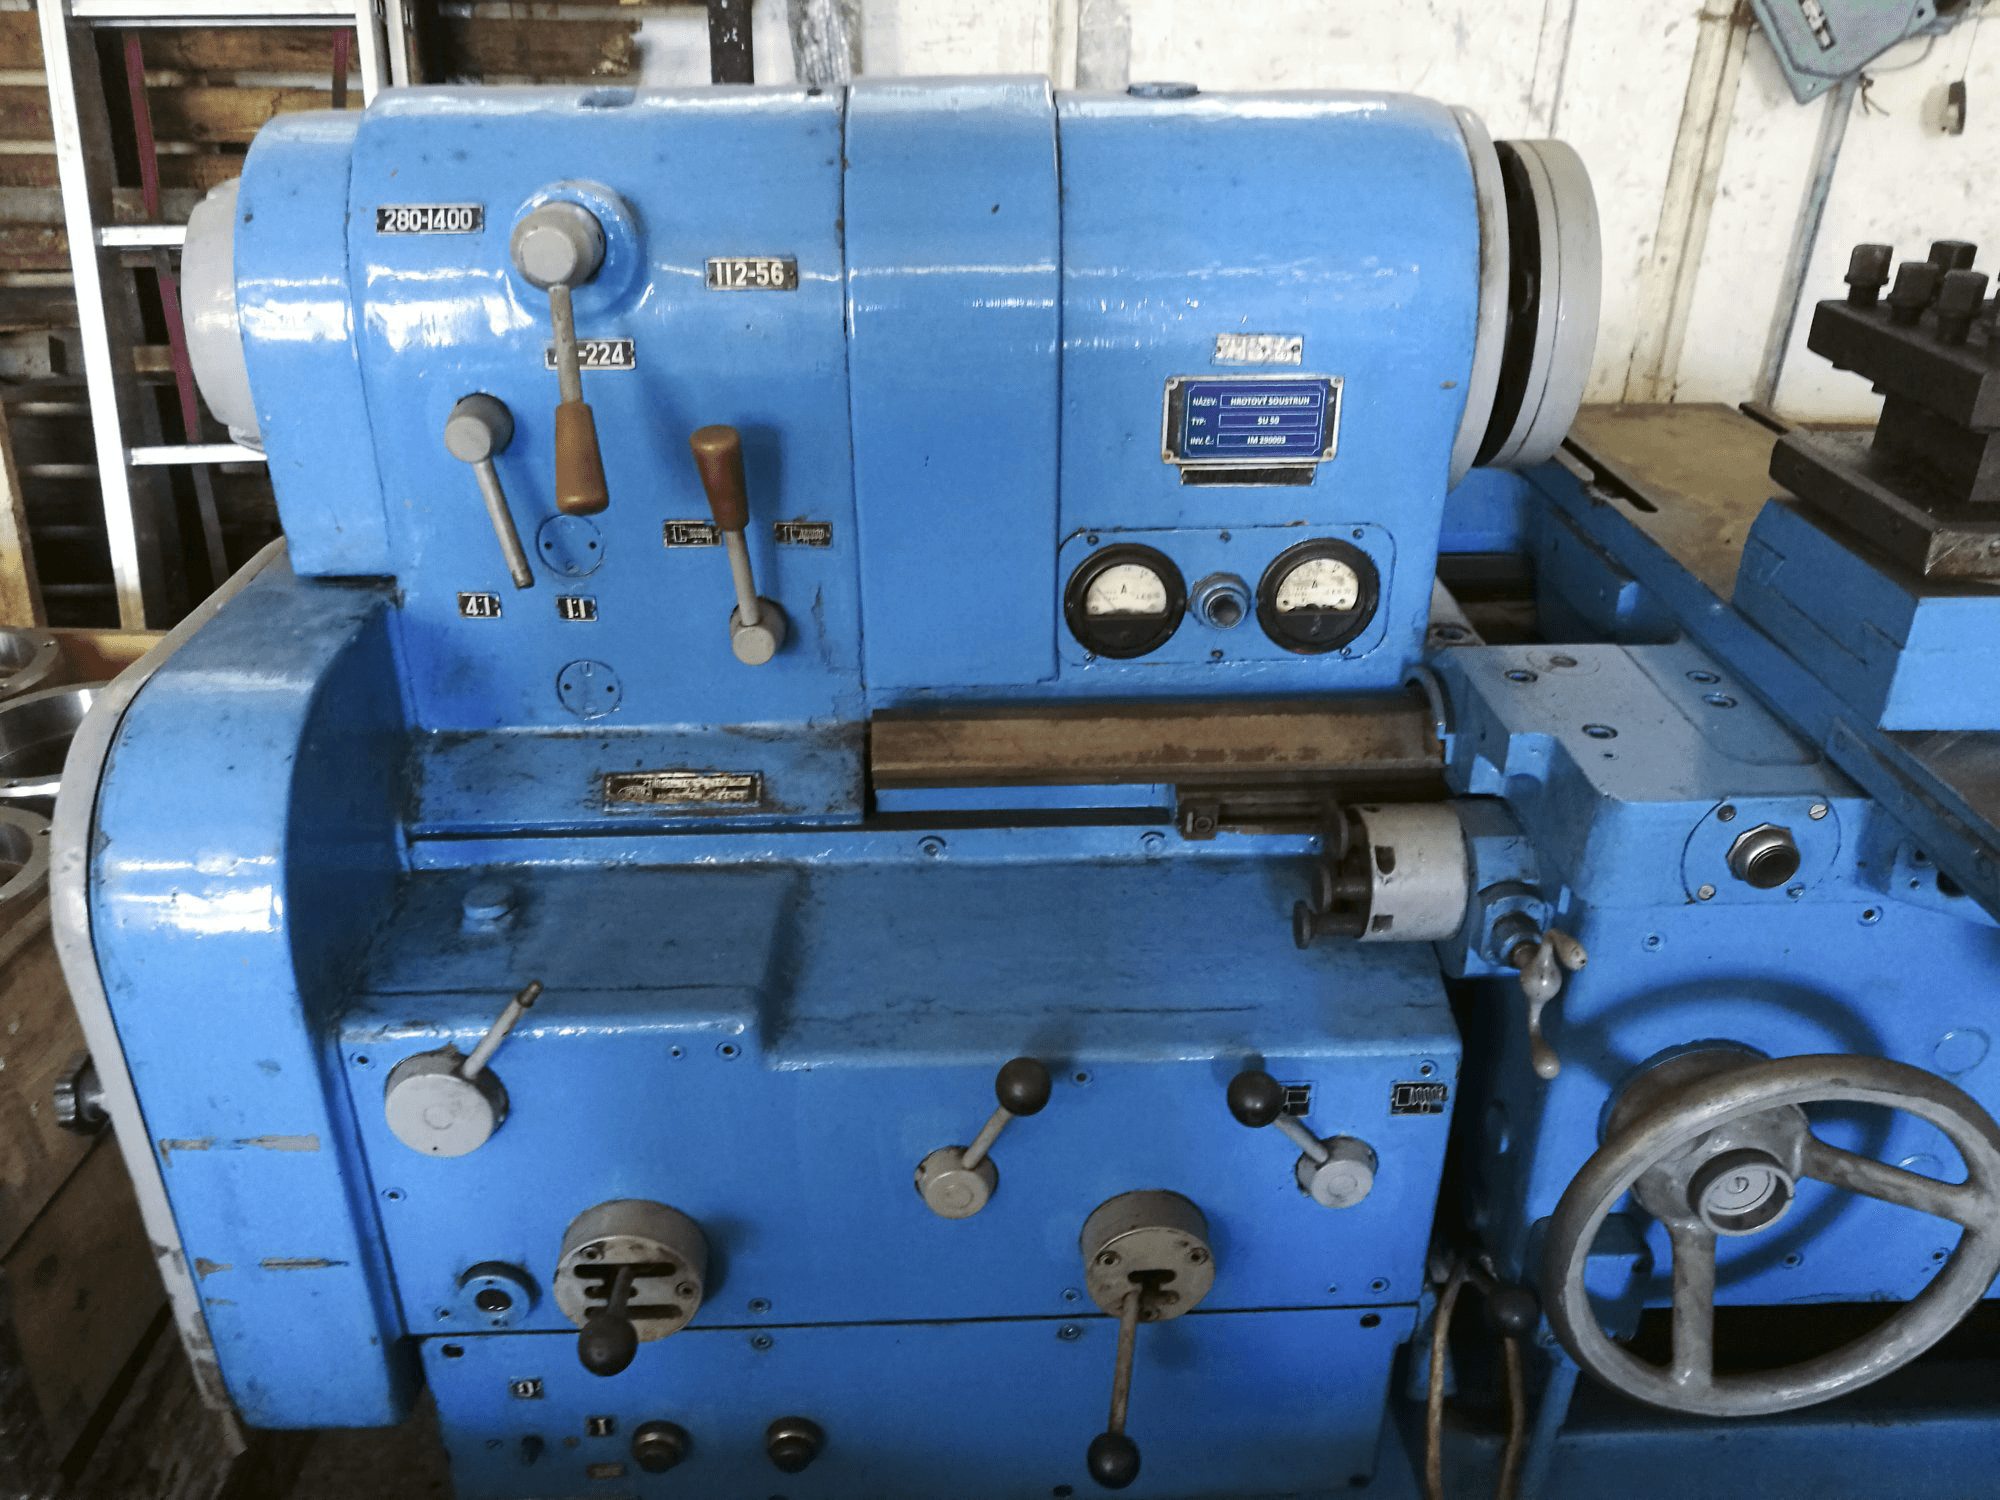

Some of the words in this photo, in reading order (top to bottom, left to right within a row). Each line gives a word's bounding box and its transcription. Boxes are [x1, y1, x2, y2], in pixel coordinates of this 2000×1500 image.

[384, 208, 473, 232] 280-1400
[716, 261, 785, 287] 112-56
[1230, 395, 1267, 406] HROTOVÝ
[1268, 395, 1310, 406] SOUSTRUH
[1257, 415, 1269, 425] SU
